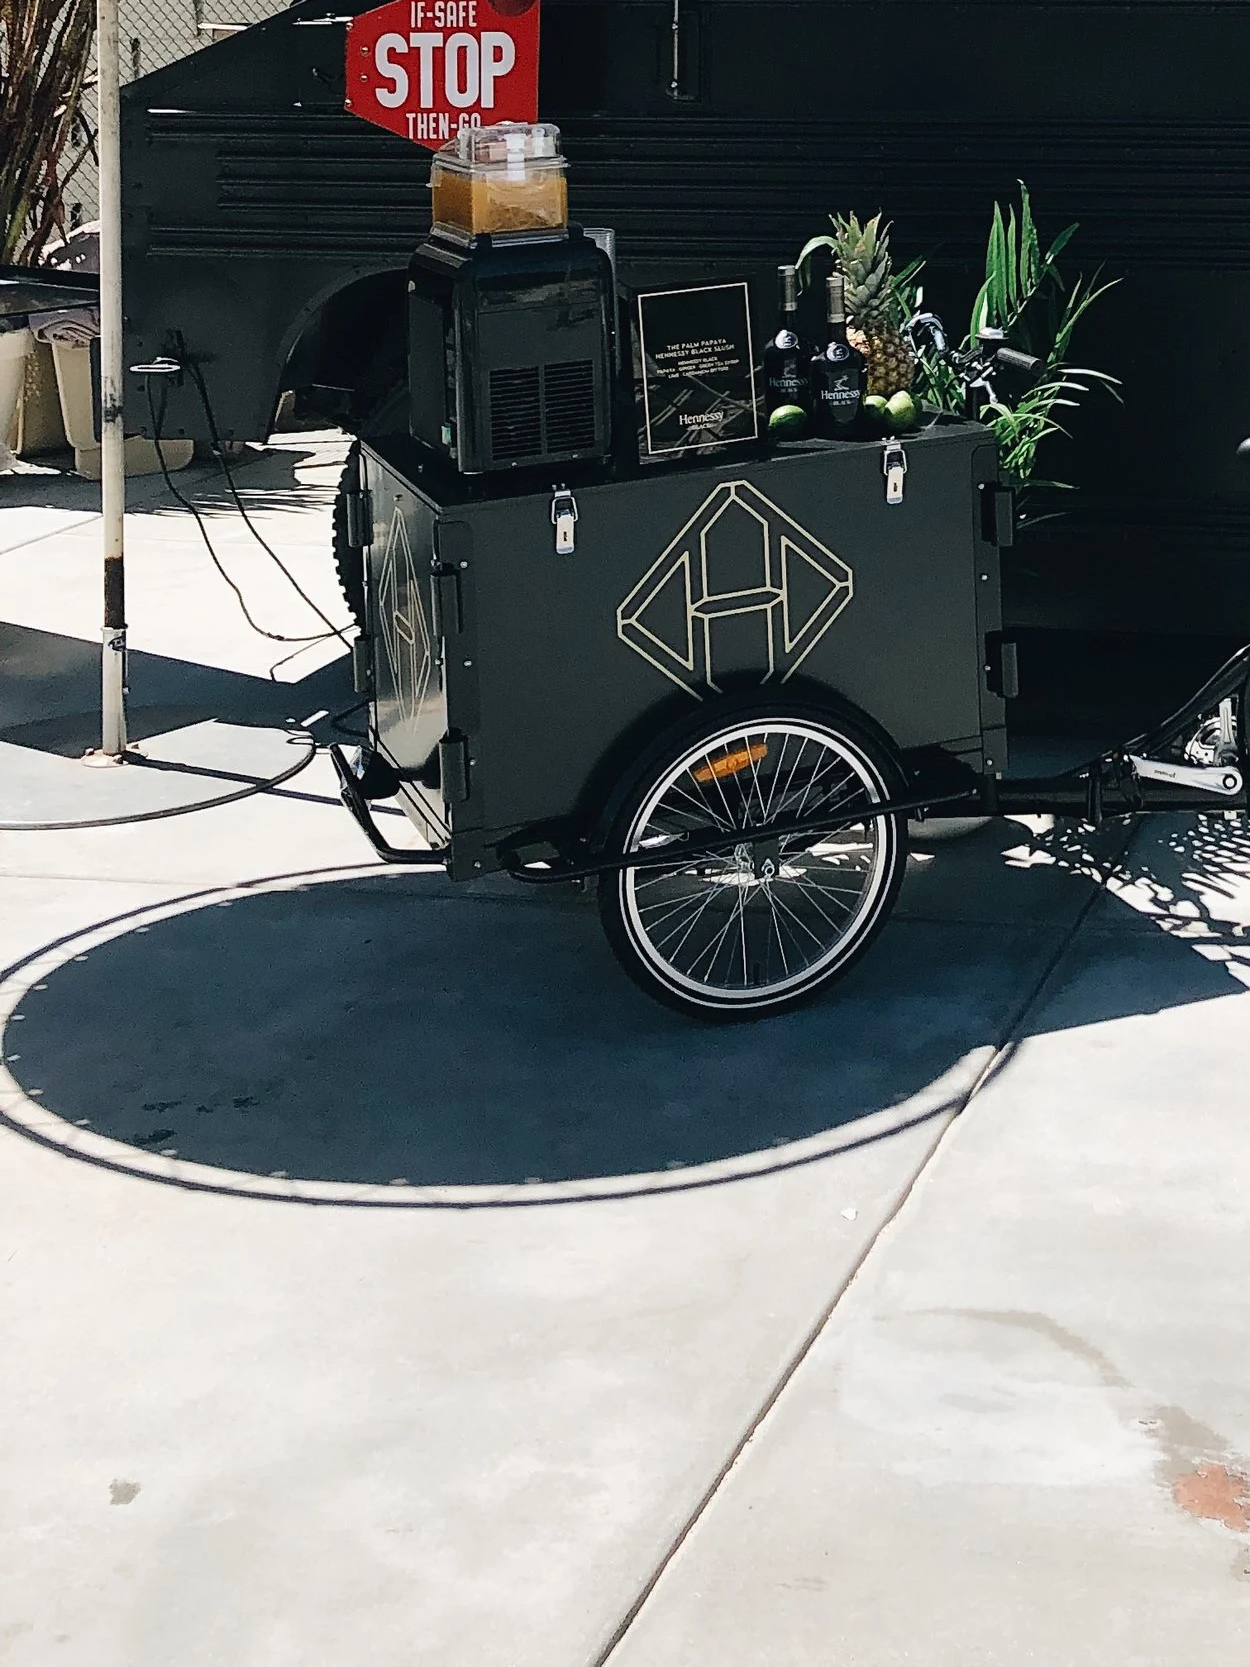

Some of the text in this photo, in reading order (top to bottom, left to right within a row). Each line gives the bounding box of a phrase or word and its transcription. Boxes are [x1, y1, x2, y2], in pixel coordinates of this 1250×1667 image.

[411, 1, 477, 28] IF-SAFE
[375, 31, 515, 108] STOP
[701, 338, 727, 347] PAPAYA
[821, 389, 860, 400] Hennessy
[679, 411, 724, 426] Hennessy
